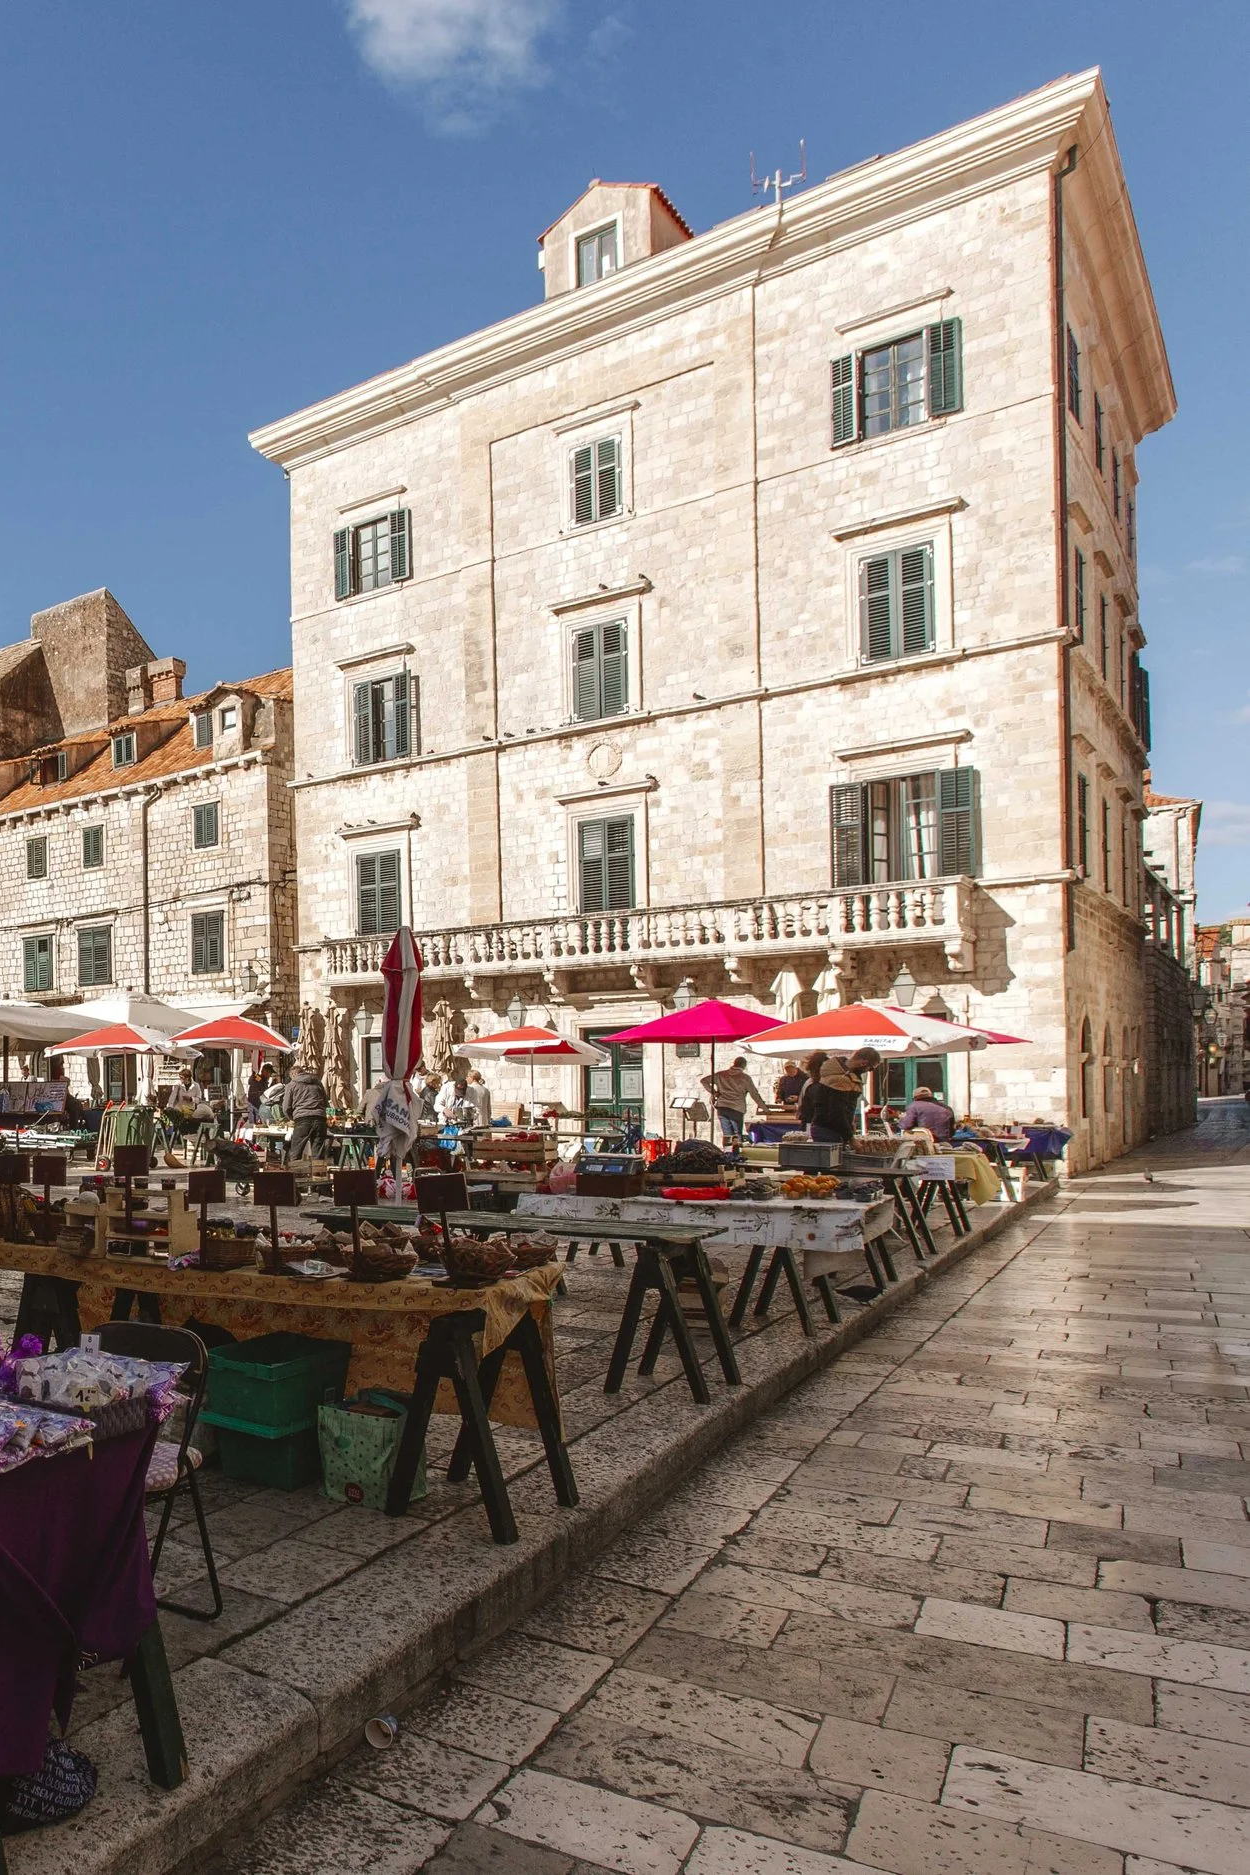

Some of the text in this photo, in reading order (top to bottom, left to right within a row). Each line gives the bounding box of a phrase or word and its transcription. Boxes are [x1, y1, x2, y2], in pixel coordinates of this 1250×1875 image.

[85, 1346, 94, 1354] kn
[17, 1793, 37, 1808] ITT
[41, 1801, 68, 1815] VAG
